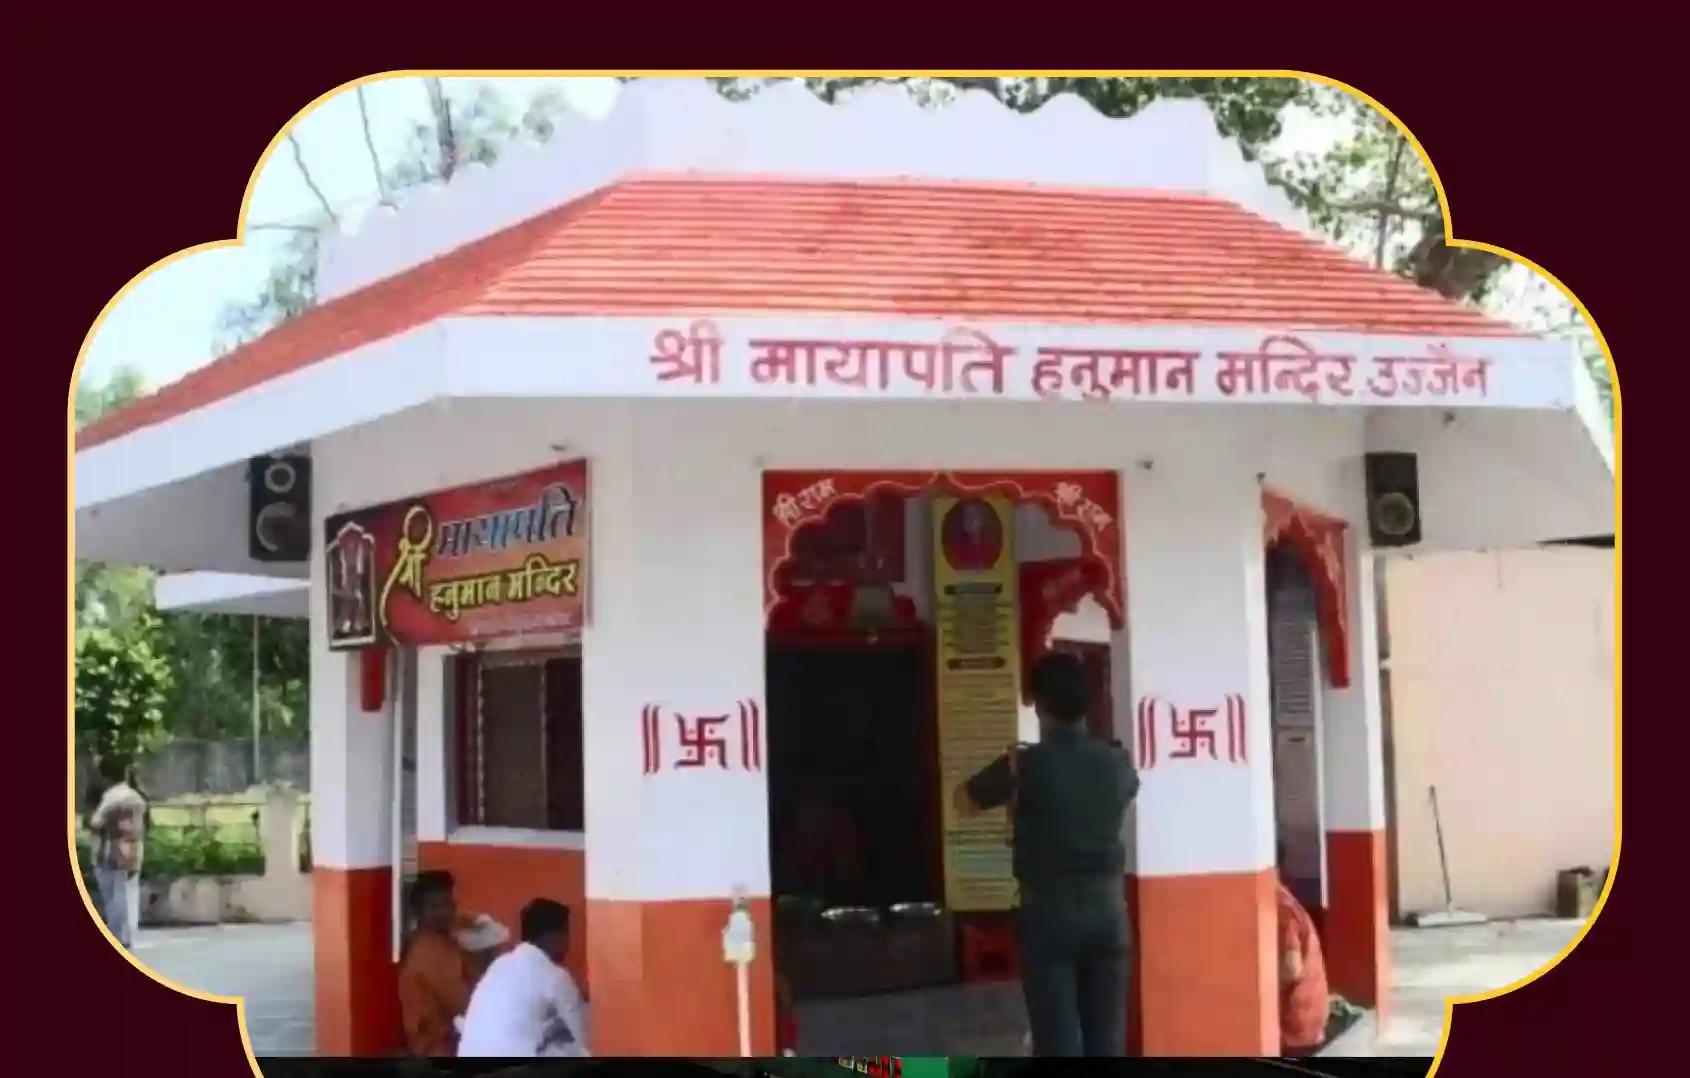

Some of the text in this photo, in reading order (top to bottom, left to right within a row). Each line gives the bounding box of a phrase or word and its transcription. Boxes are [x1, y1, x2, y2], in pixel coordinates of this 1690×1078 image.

[649, 317, 725, 385] श्री
[748, 326, 1016, 395] मायापति
[1031, 346, 1201, 402] हनुमान
[1216, 335, 1357, 403] मन्दिर
[429, 575, 502, 622] हनुमान
